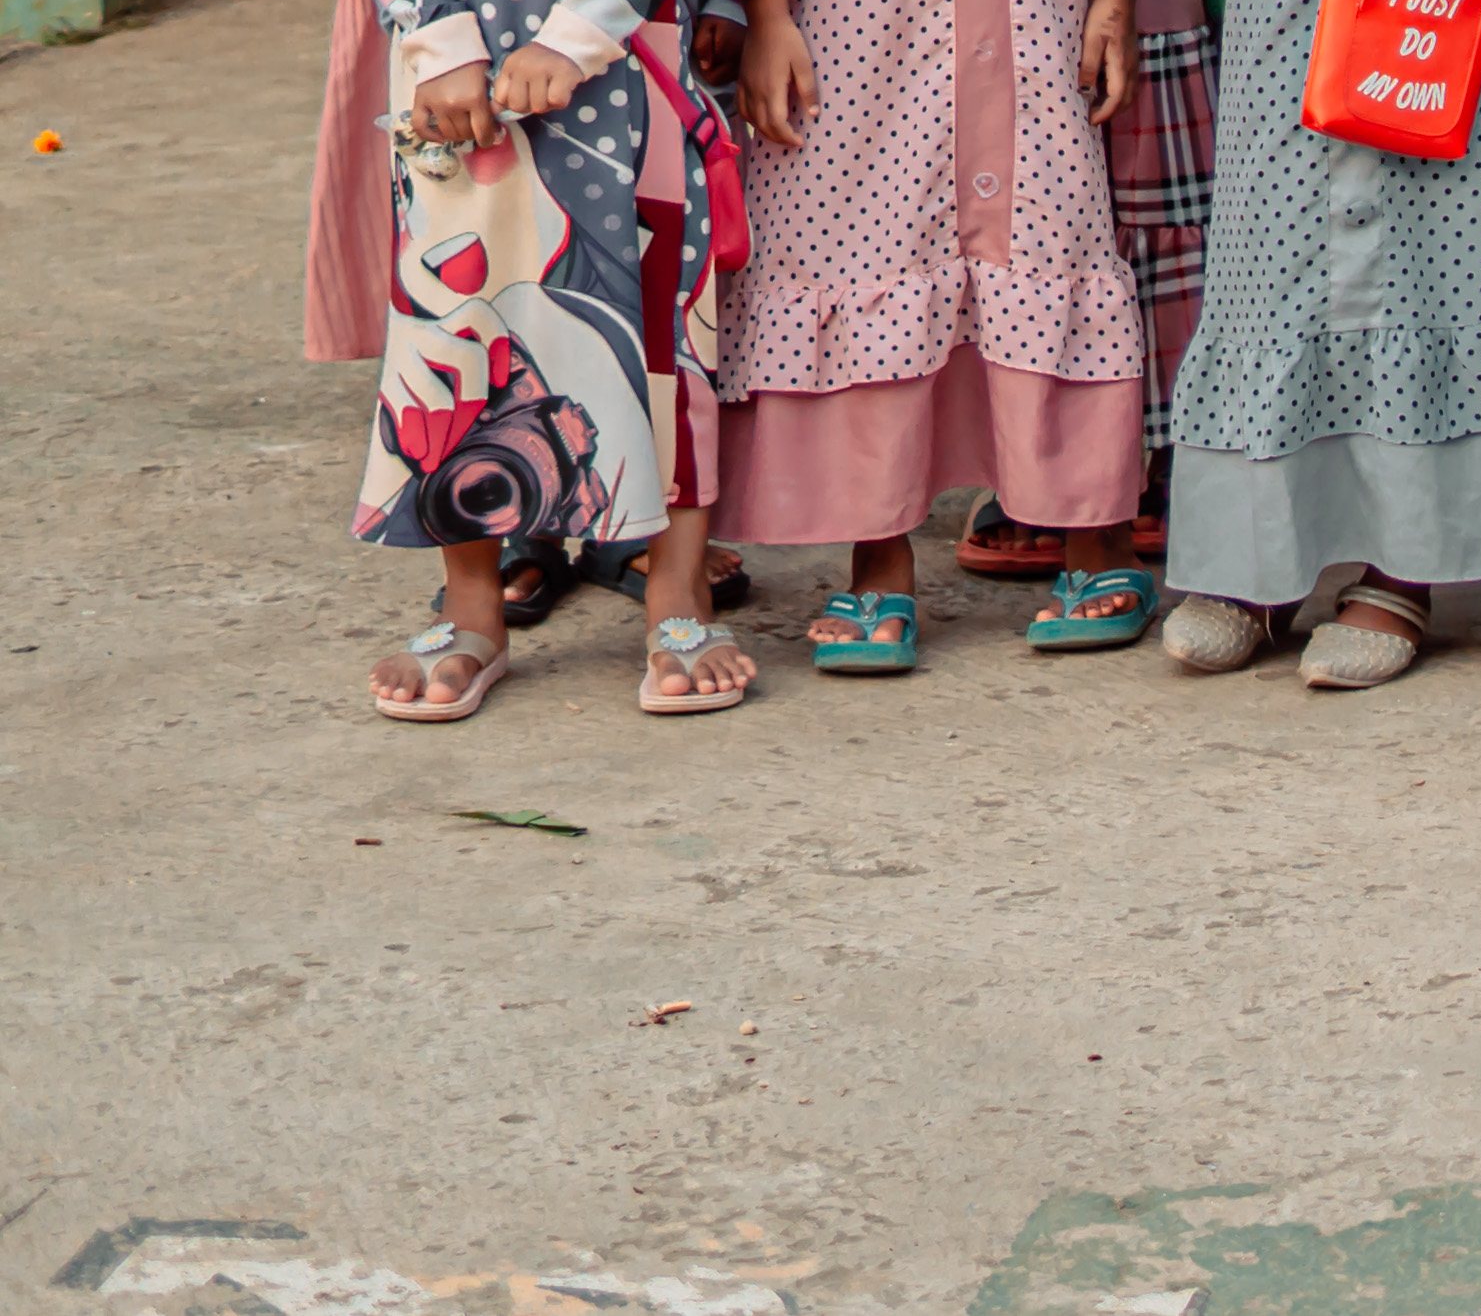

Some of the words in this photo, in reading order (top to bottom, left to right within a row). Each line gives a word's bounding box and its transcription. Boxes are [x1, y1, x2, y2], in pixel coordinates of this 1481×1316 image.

[1400, 27, 1437, 60] DO
[1357, 70, 1399, 102] MY
[1396, 81, 1446, 111] OWN
